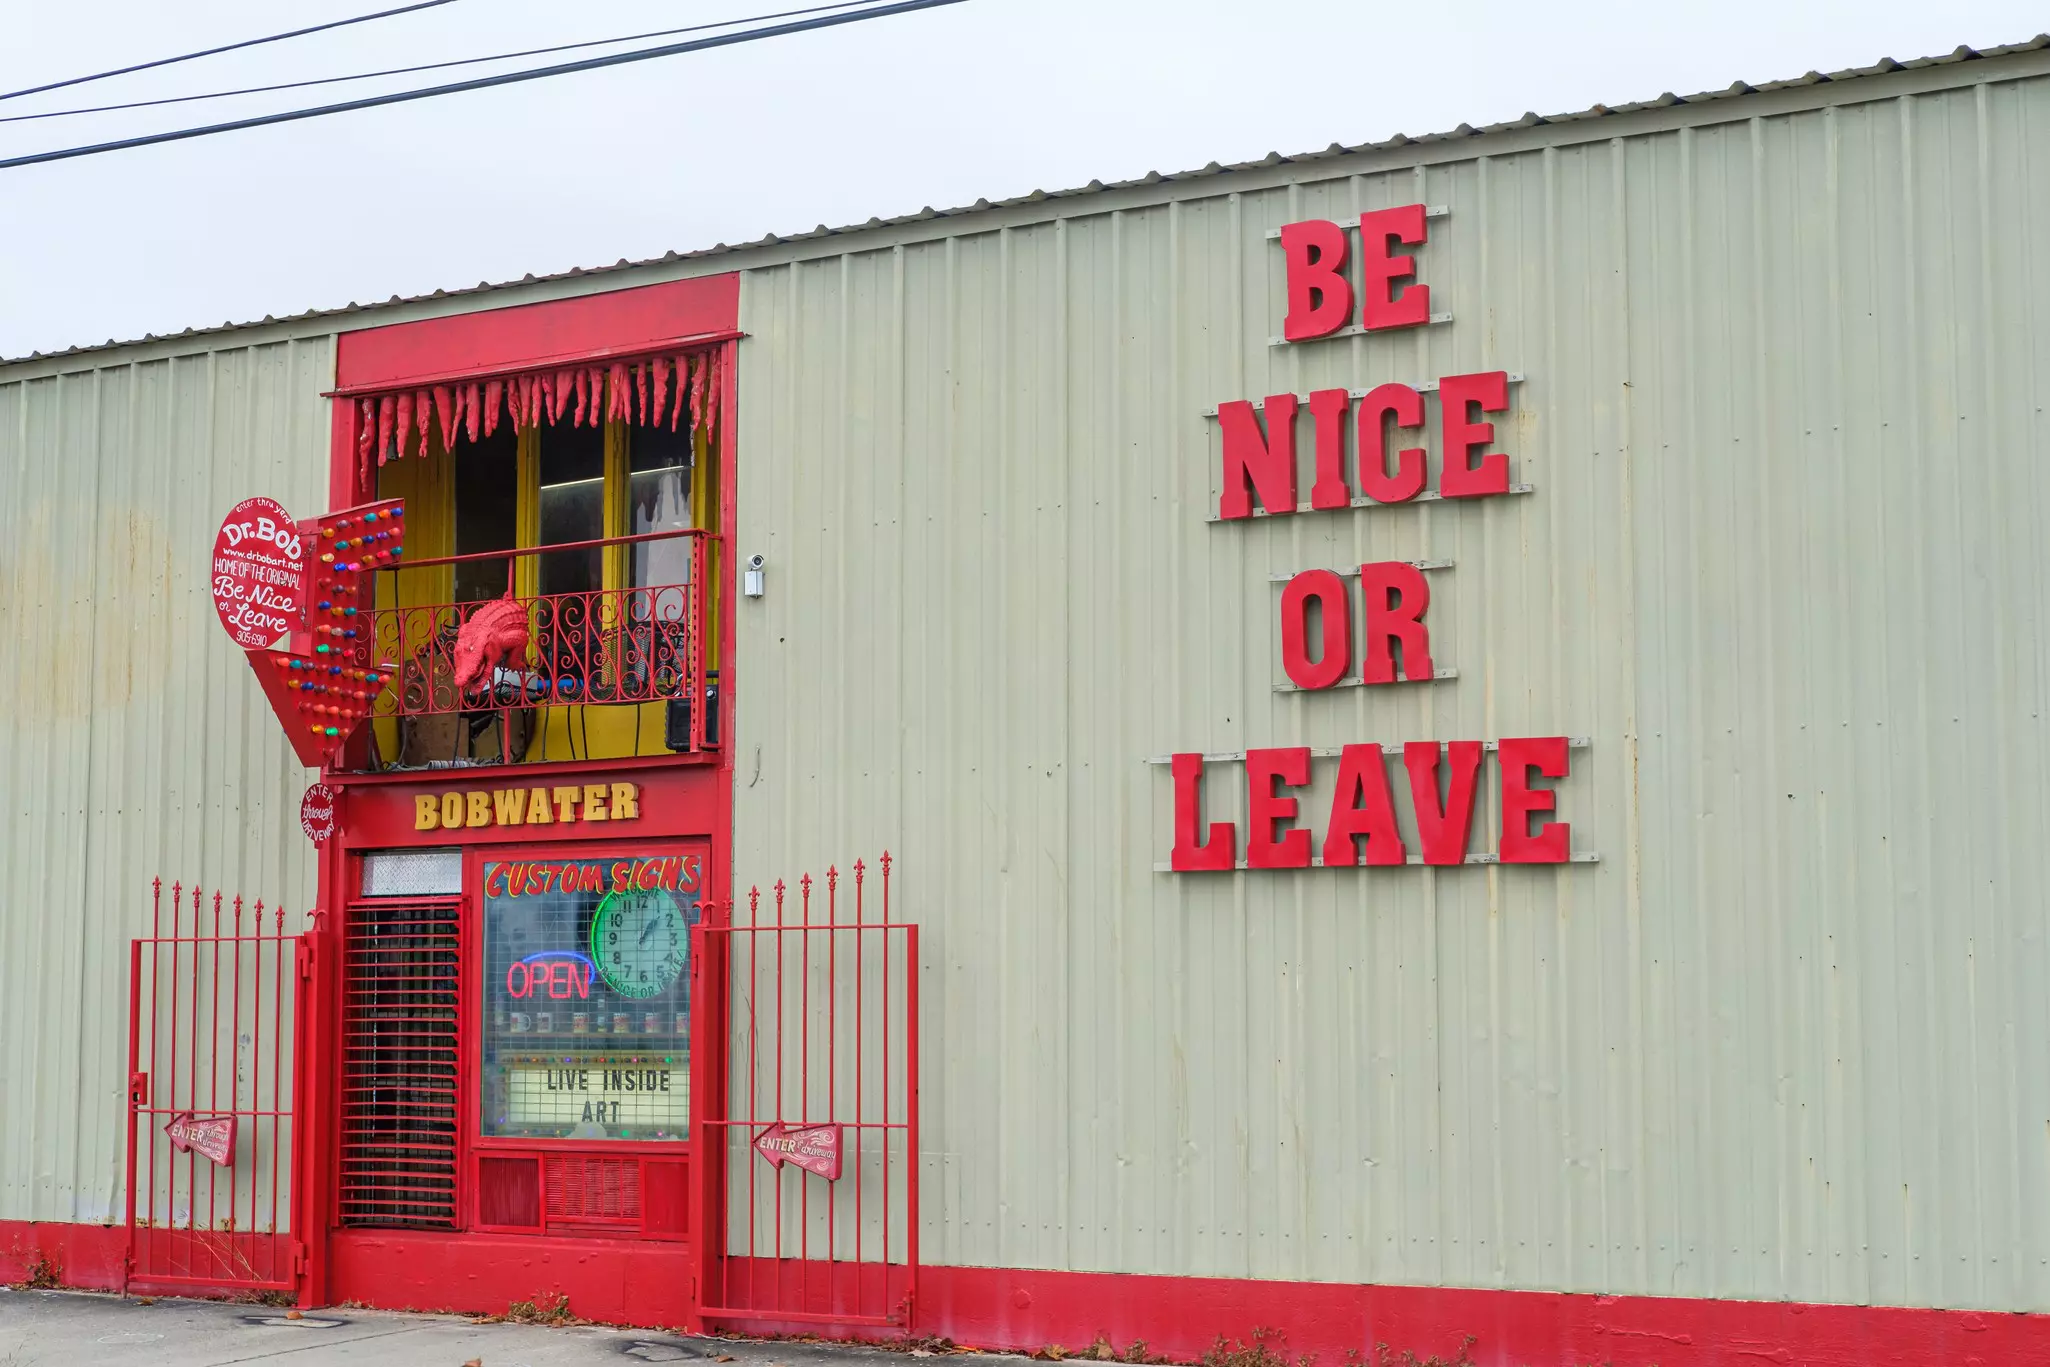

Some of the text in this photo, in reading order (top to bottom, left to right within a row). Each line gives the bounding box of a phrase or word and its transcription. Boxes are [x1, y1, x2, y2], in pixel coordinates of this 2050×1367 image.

[1280, 203, 1430, 343] BE
[1218, 371, 1510, 520] NICE
[236, 498, 292, 525] enter thru yard
[223, 548, 303, 571] www.drbobart.net
[215, 557, 300, 590] HOME OF THE ORIGINAL
[214, 575, 296, 612] Be Nice
[219, 601, 288, 632] or Leave
[1281, 561, 1434, 689] OR
[306, 784, 334, 804] ENTER
[1171, 737, 1570, 872] LEAVE
[302, 803, 333, 821] through
[415, 782, 639, 830] BOBWATER
[302, 818, 335, 841] DRIVEWAY
[485, 855, 701, 899] CUSTOM SIGNS
[623, 900, 632, 913] 11
[637, 896, 648, 908] 12
[610, 913, 623, 927] 10
[665, 913, 674, 927] 2
[608, 932, 617, 945] 9
[669, 932, 678, 946] 3
[613, 951, 621, 964] 8
[507, 962, 590, 999] OPEN
[624, 964, 632, 978] 7
[640, 970, 648, 983] 6
[656, 964, 665, 979] 5
[640, 985, 655, 998] OR
[547, 1069, 669, 1091] LIVE INSIDE
[582, 1101, 619, 1122] ART
[172, 1124, 204, 1143] ENTER
[759, 1137, 796, 1153] ENTER
[800, 1142, 836, 1163] driveway
